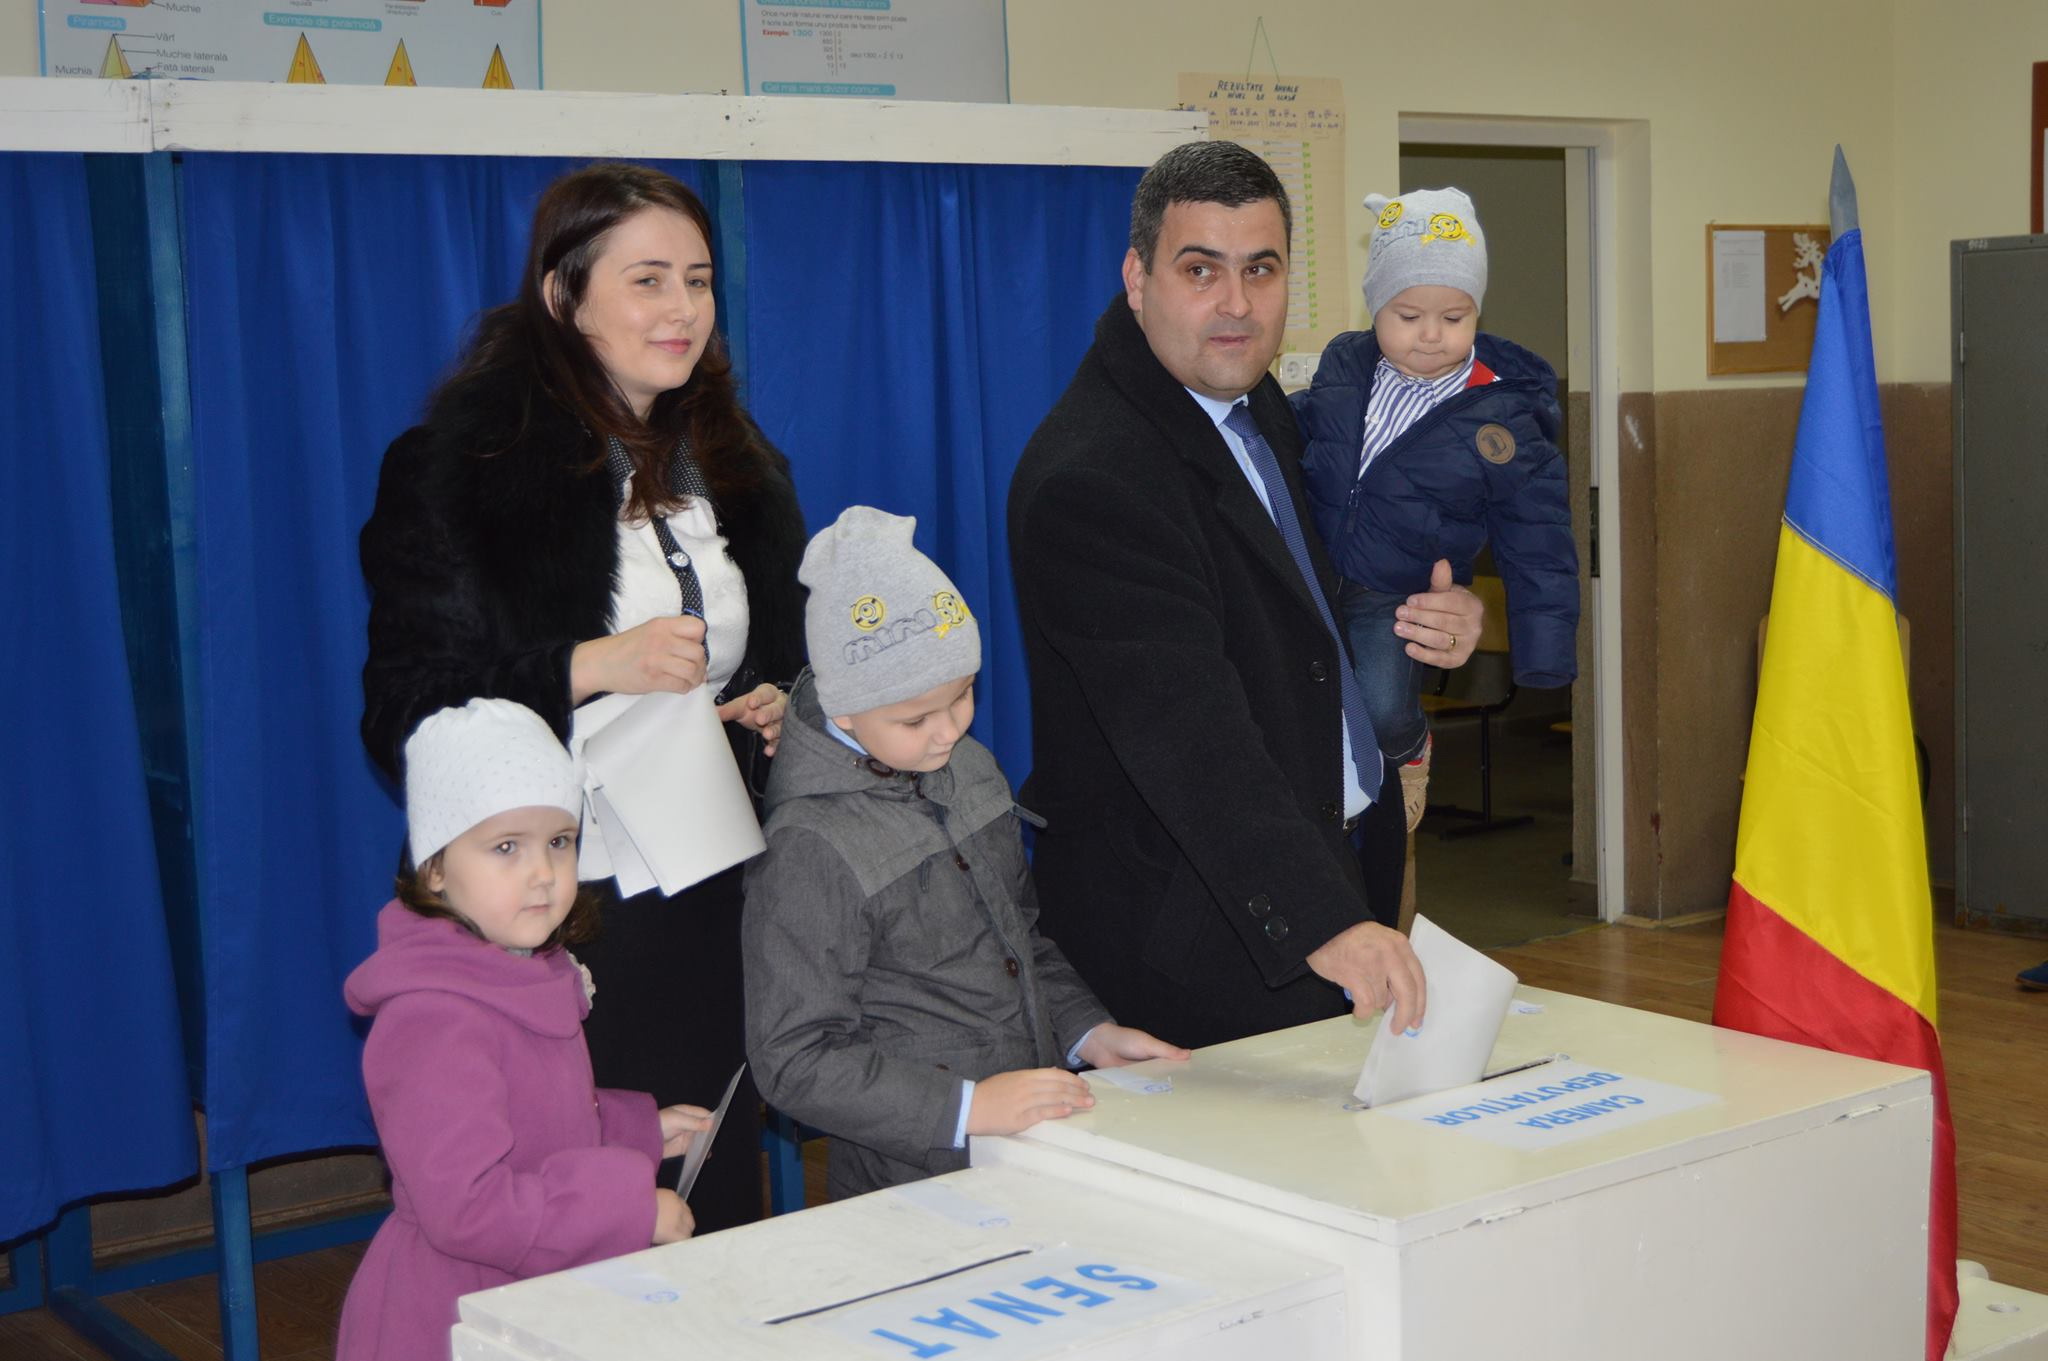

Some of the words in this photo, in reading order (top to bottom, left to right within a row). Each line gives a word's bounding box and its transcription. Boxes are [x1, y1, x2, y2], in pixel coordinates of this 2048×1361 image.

[166, 3, 201, 13] Muchie
[269, 14, 313, 26] Exemple
[316, 17, 329, 26] de
[156, 49, 191, 60] Muchie
[55, 65, 92, 75] Muchia
[1217, 80, 1263, 92] REZULTATE
[1209, 91, 1218, 99] LA
[1516, 1094, 1645, 1130] CAMERA
[870, 1263, 1158, 1359] SENAT
